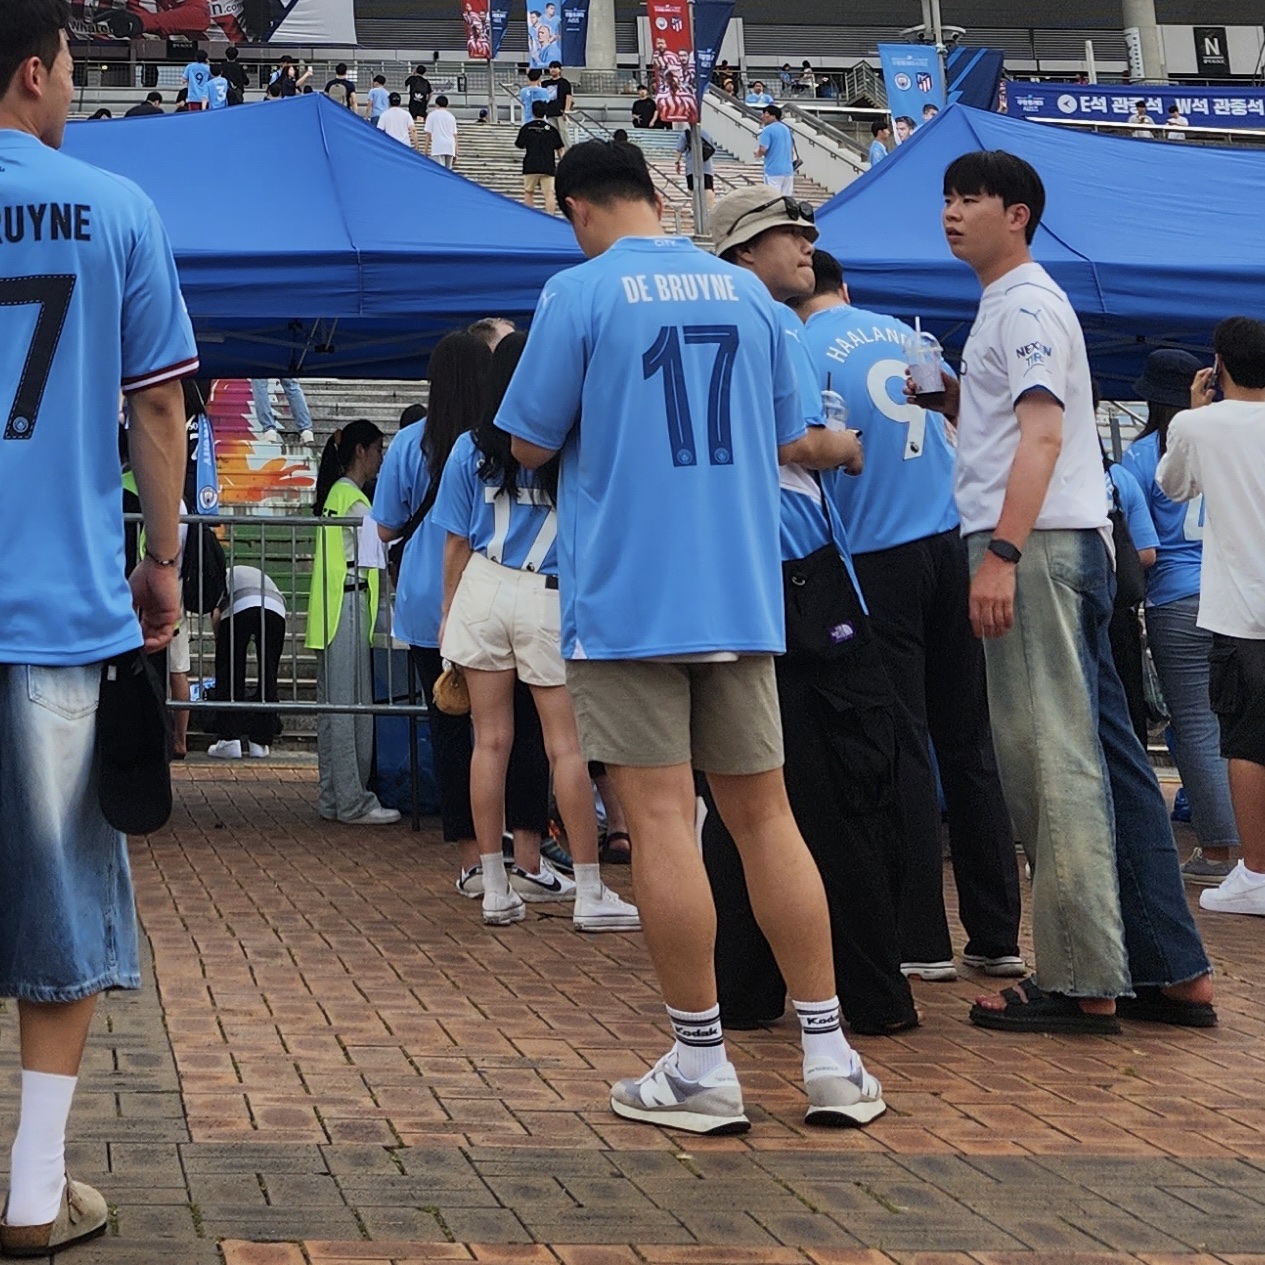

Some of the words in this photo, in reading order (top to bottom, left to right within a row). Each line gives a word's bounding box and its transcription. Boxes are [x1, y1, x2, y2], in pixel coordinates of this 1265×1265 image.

[1204, 37, 1221, 55] N
[195, 72, 203, 84] 9
[216, 86, 226, 101] 3
[1080, 96, 1108, 113] E석
[1175, 98, 1209, 115] W석
[1212, 97, 1264, 115] 관중석
[621, 275, 653, 303] DE
[654, 274, 739, 302] BRUYNE
[641, 324, 740, 467] 17
[867, 359, 927, 461] 9
[675, 1026, 718, 1036] Kodak
